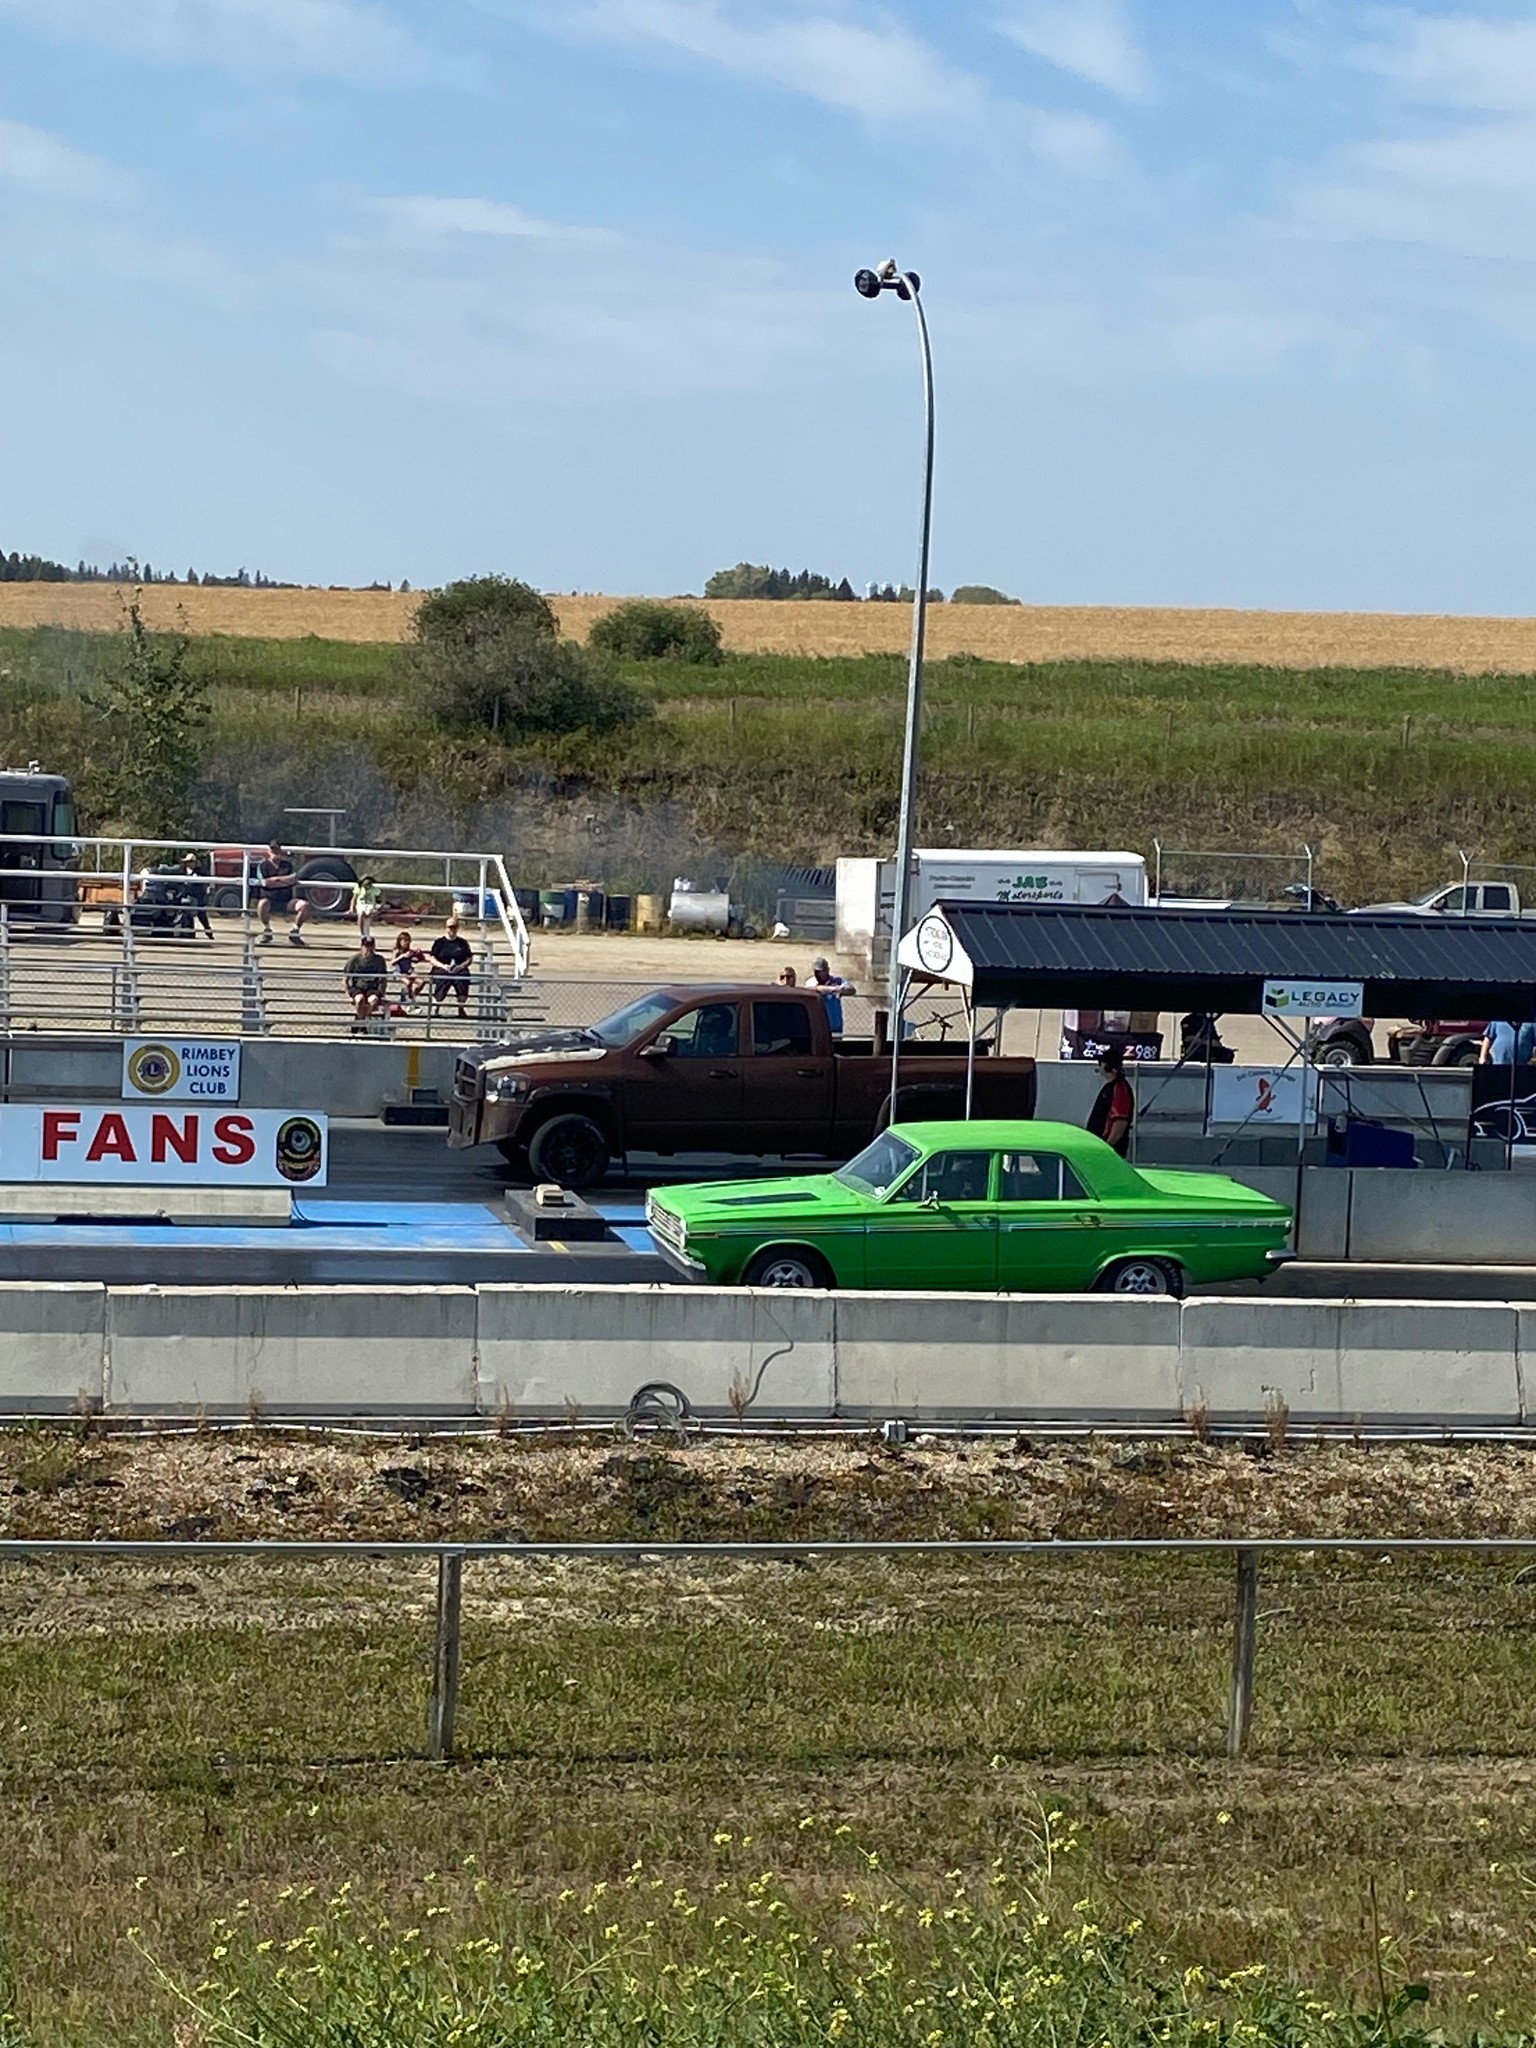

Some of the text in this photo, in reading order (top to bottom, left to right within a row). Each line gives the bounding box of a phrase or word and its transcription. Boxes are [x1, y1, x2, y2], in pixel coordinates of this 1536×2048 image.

[1291, 990, 1360, 1003] LEGACY
[181, 1048, 236, 1061] RIMBEY
[186, 1065, 230, 1078] LIONS
[189, 1082, 227, 1095] CLUB
[42, 1112, 256, 1165] FANS
